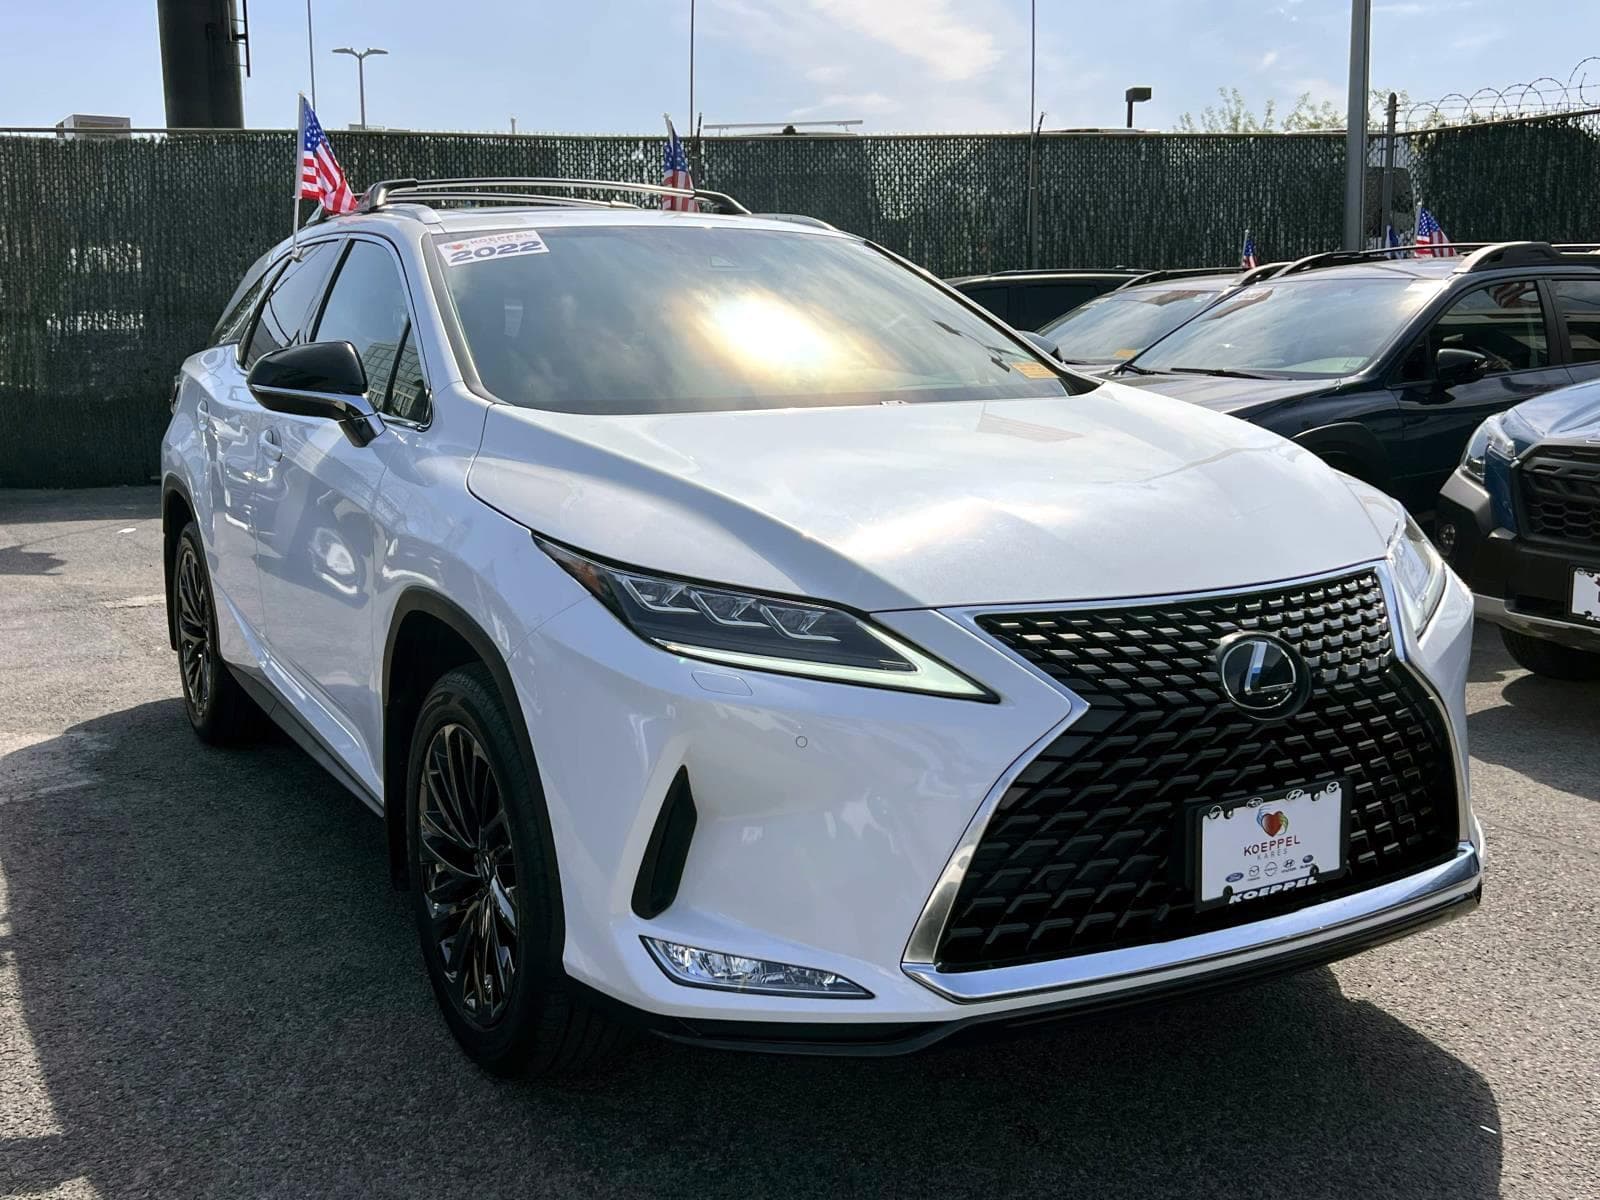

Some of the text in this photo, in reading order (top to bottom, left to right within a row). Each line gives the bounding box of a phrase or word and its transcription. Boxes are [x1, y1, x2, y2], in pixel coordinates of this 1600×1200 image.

[450, 240, 542, 263] 2022
[1243, 835, 1301, 857] KOEPPEL
[1257, 848, 1289, 860] KARES
[1228, 876, 1318, 904] KOEPPEL
